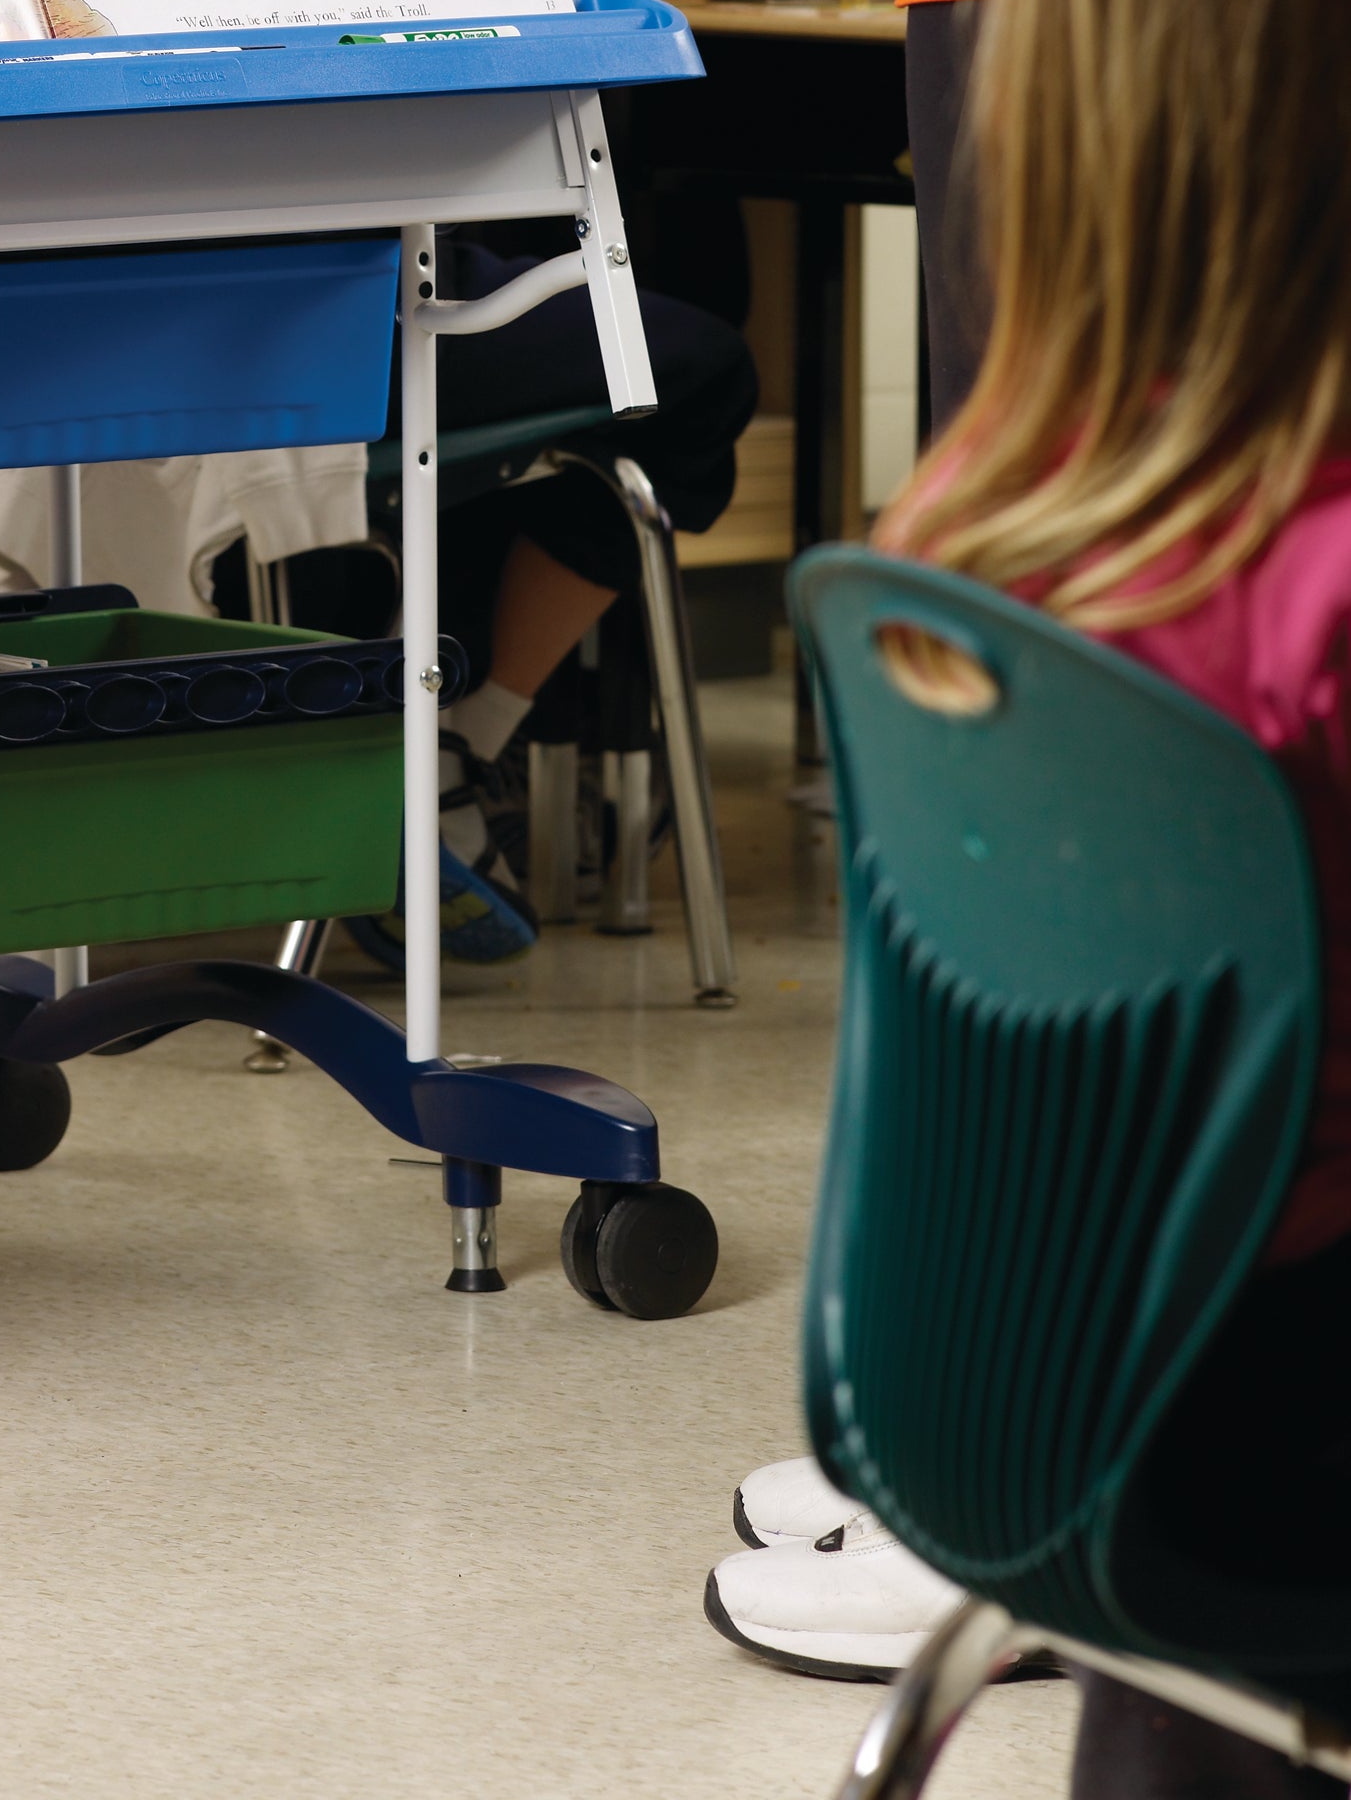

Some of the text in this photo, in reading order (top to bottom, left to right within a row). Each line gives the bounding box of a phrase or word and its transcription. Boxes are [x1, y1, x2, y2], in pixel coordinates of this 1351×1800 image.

[546, 0, 557, 11] 13
[175, 3, 431, 28] “Well then, be off with you,” said the Troll.
[476, 30, 492, 39] odor
